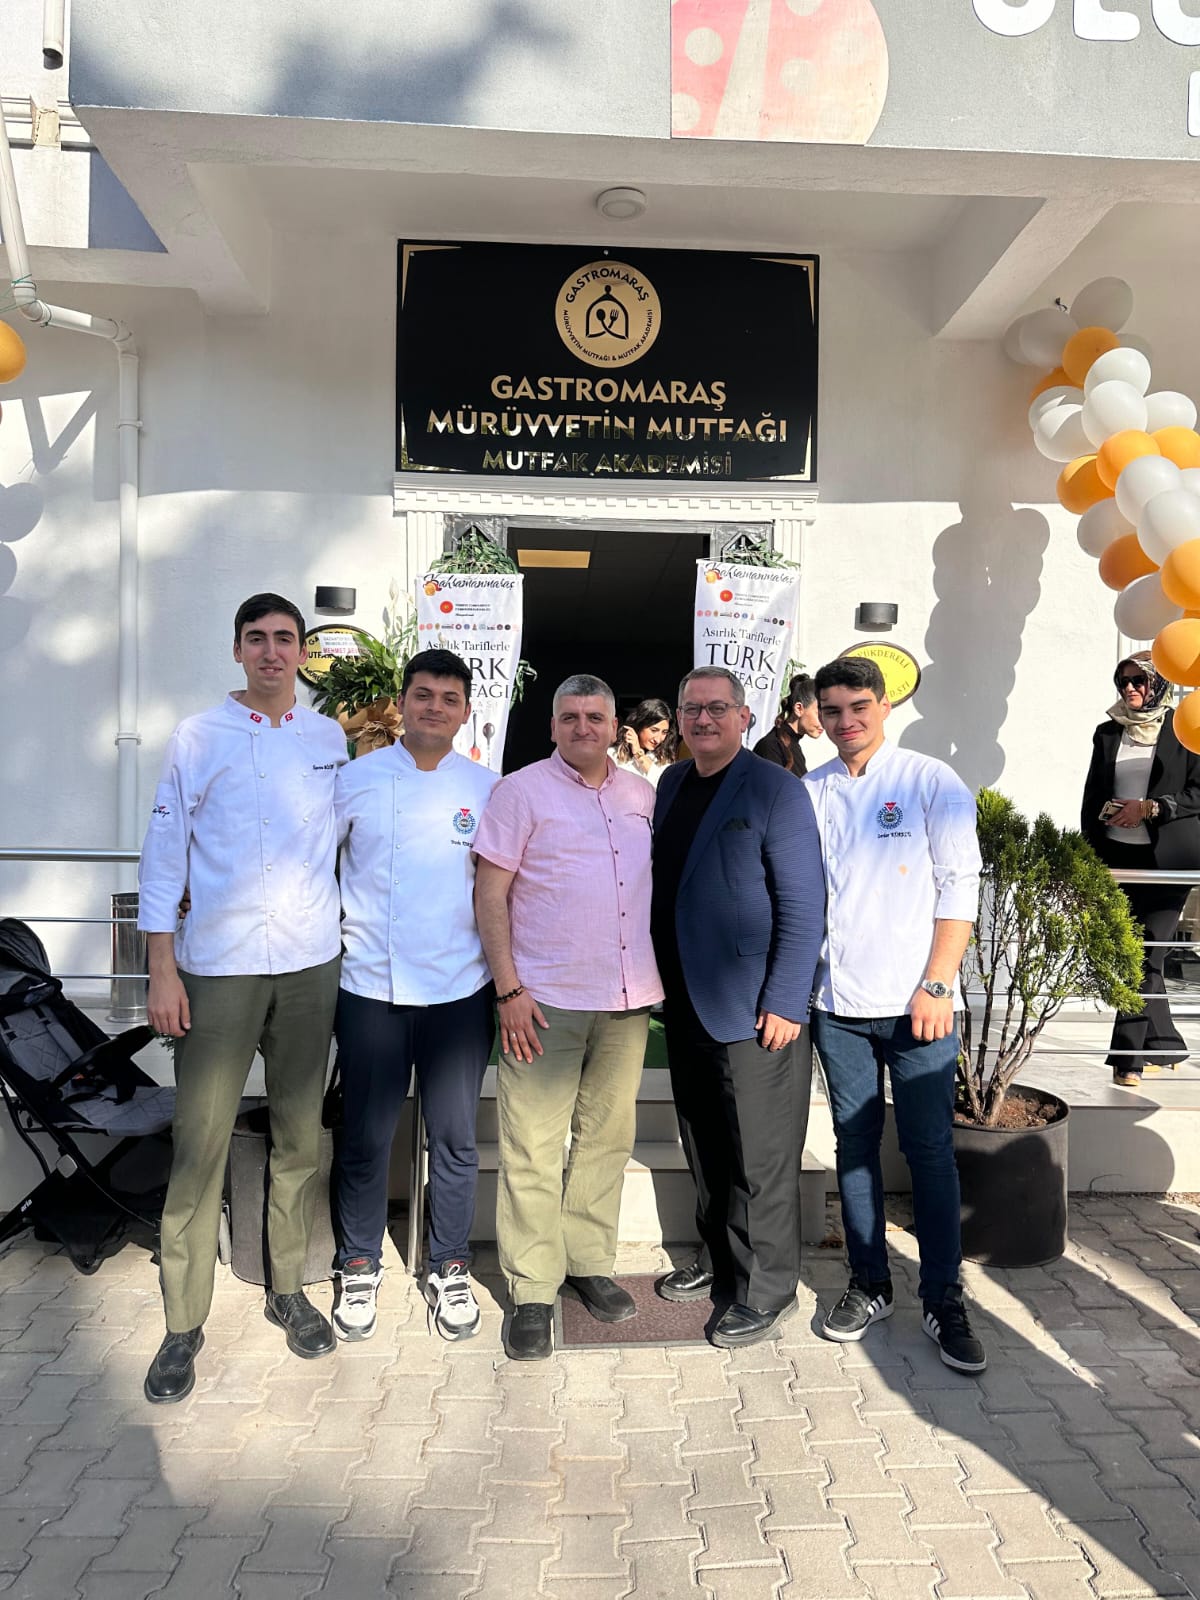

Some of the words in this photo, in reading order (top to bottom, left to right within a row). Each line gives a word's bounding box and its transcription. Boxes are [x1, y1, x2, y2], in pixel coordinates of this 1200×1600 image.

[565, 268, 650, 303] GASTROMARAŞ
[582, 347, 610, 361] MUTFAĞI
[618, 343, 641, 360] MUTFAK
[490, 375, 727, 411] GASTROMARAŞ
[426, 404, 635, 440] MÜRÜVVETİN
[646, 411, 788, 443] MUTFAĞI
[482, 450, 590, 473] MUTFAK
[595, 450, 733, 476] AKADEMİSİ
[462, 640, 511, 651] Tariflerle
[702, 627, 737, 639] Asırlık
[738, 628, 781, 646] Tariflerle
[463, 654, 509, 681] RK
[705, 640, 776, 675] TÜRK
[470, 681, 509, 699] FAĞI
[732, 670, 775, 692] TFAĞI
